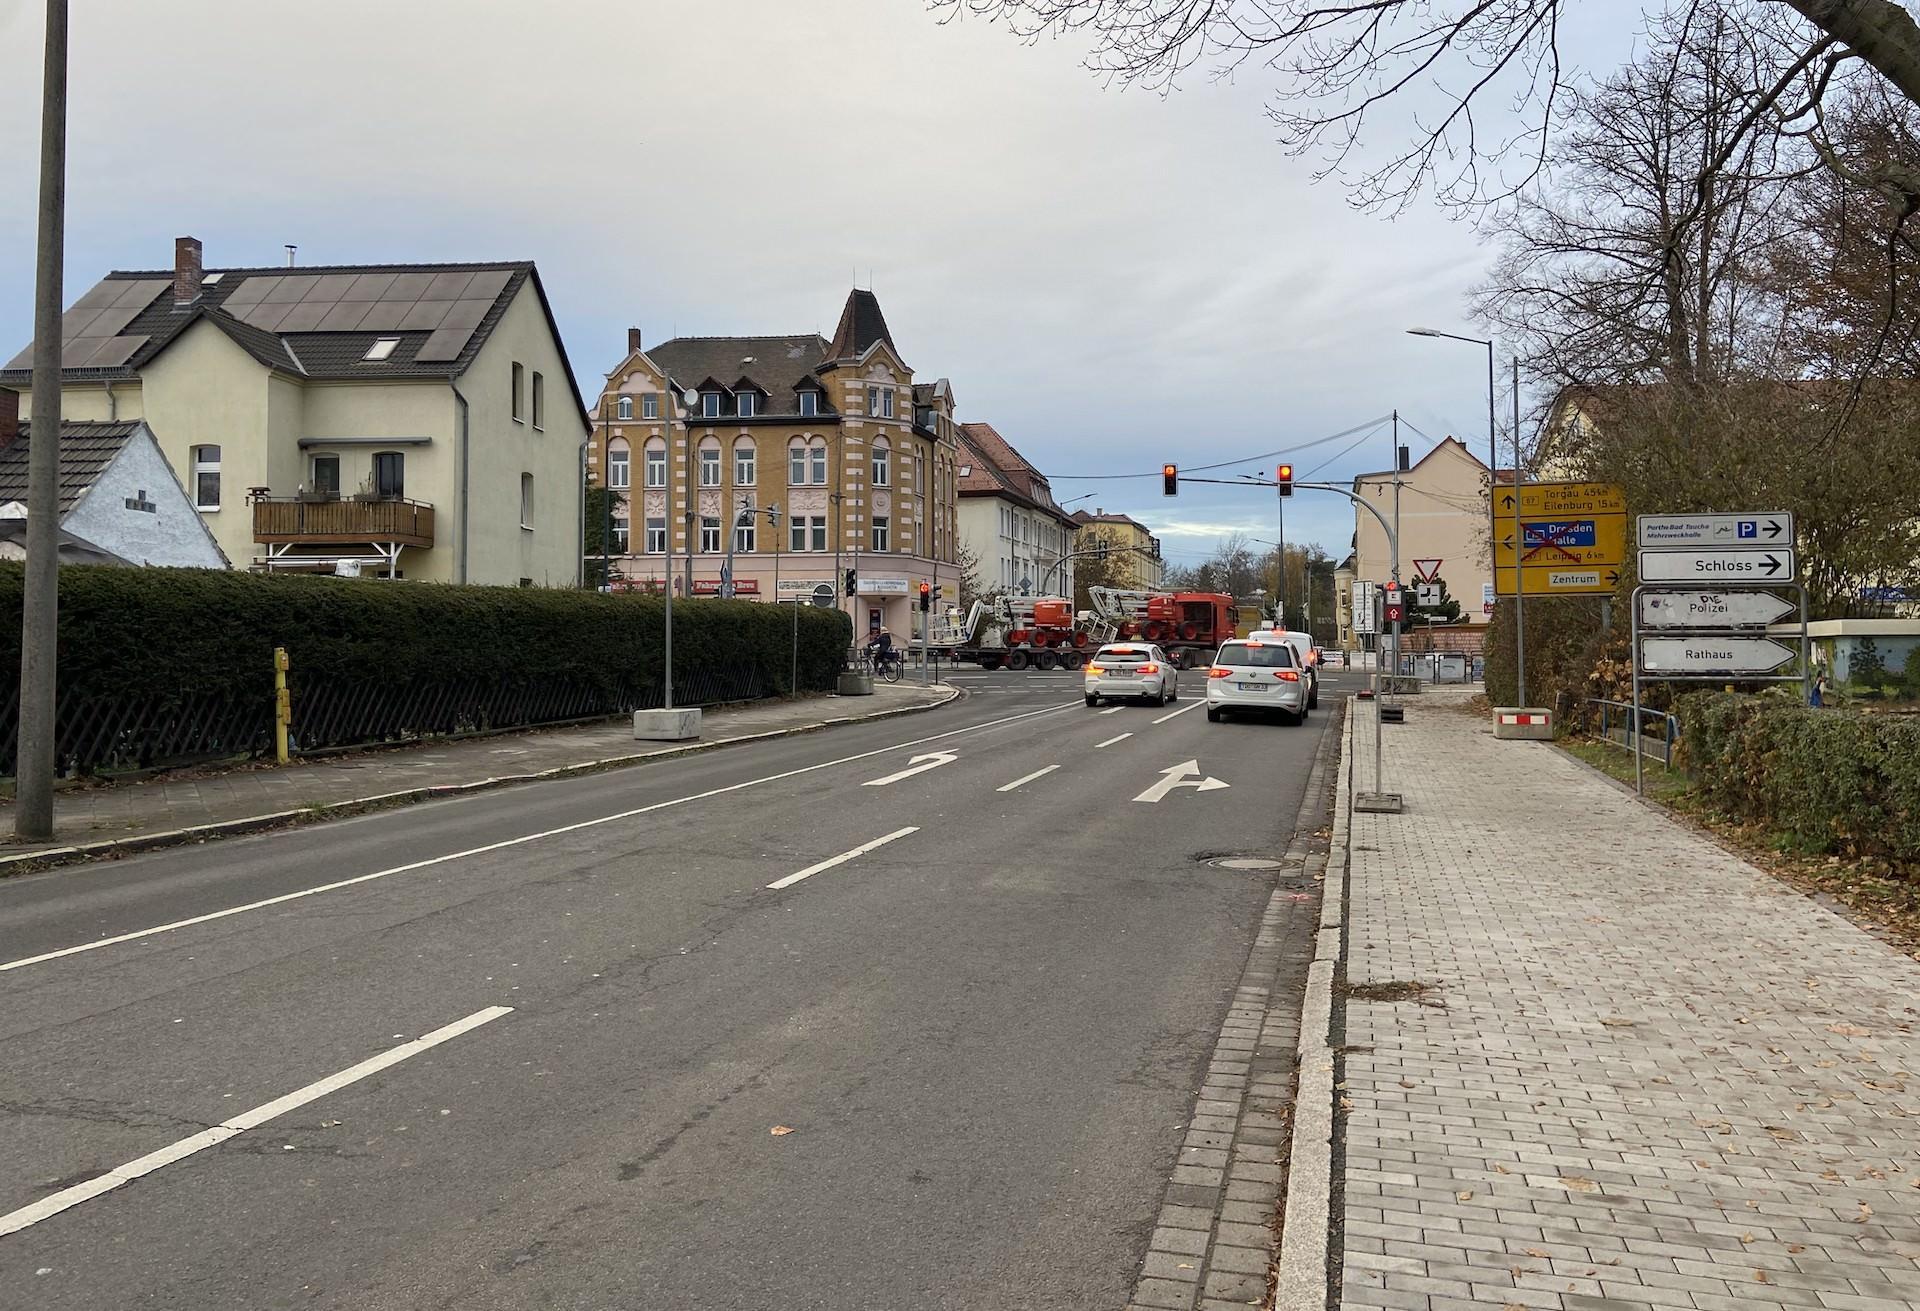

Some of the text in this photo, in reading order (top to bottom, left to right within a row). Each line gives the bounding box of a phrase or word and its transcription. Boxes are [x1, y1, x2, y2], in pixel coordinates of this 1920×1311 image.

[1544, 489, 1579, 500] Torgau
[1583, 488, 1596, 496] 45
[1544, 501, 1593, 511] Eilenburg
[1598, 500, 1608, 508] 15
[1586, 551, 1593, 560] 6
[1695, 560, 1753, 571] Schloss
[1552, 575, 1597, 585] Zentrum
[1700, 595, 1722, 604] DIE
[1689, 603, 1729, 613] Polizei
[1685, 649, 1734, 659] Rathaus
